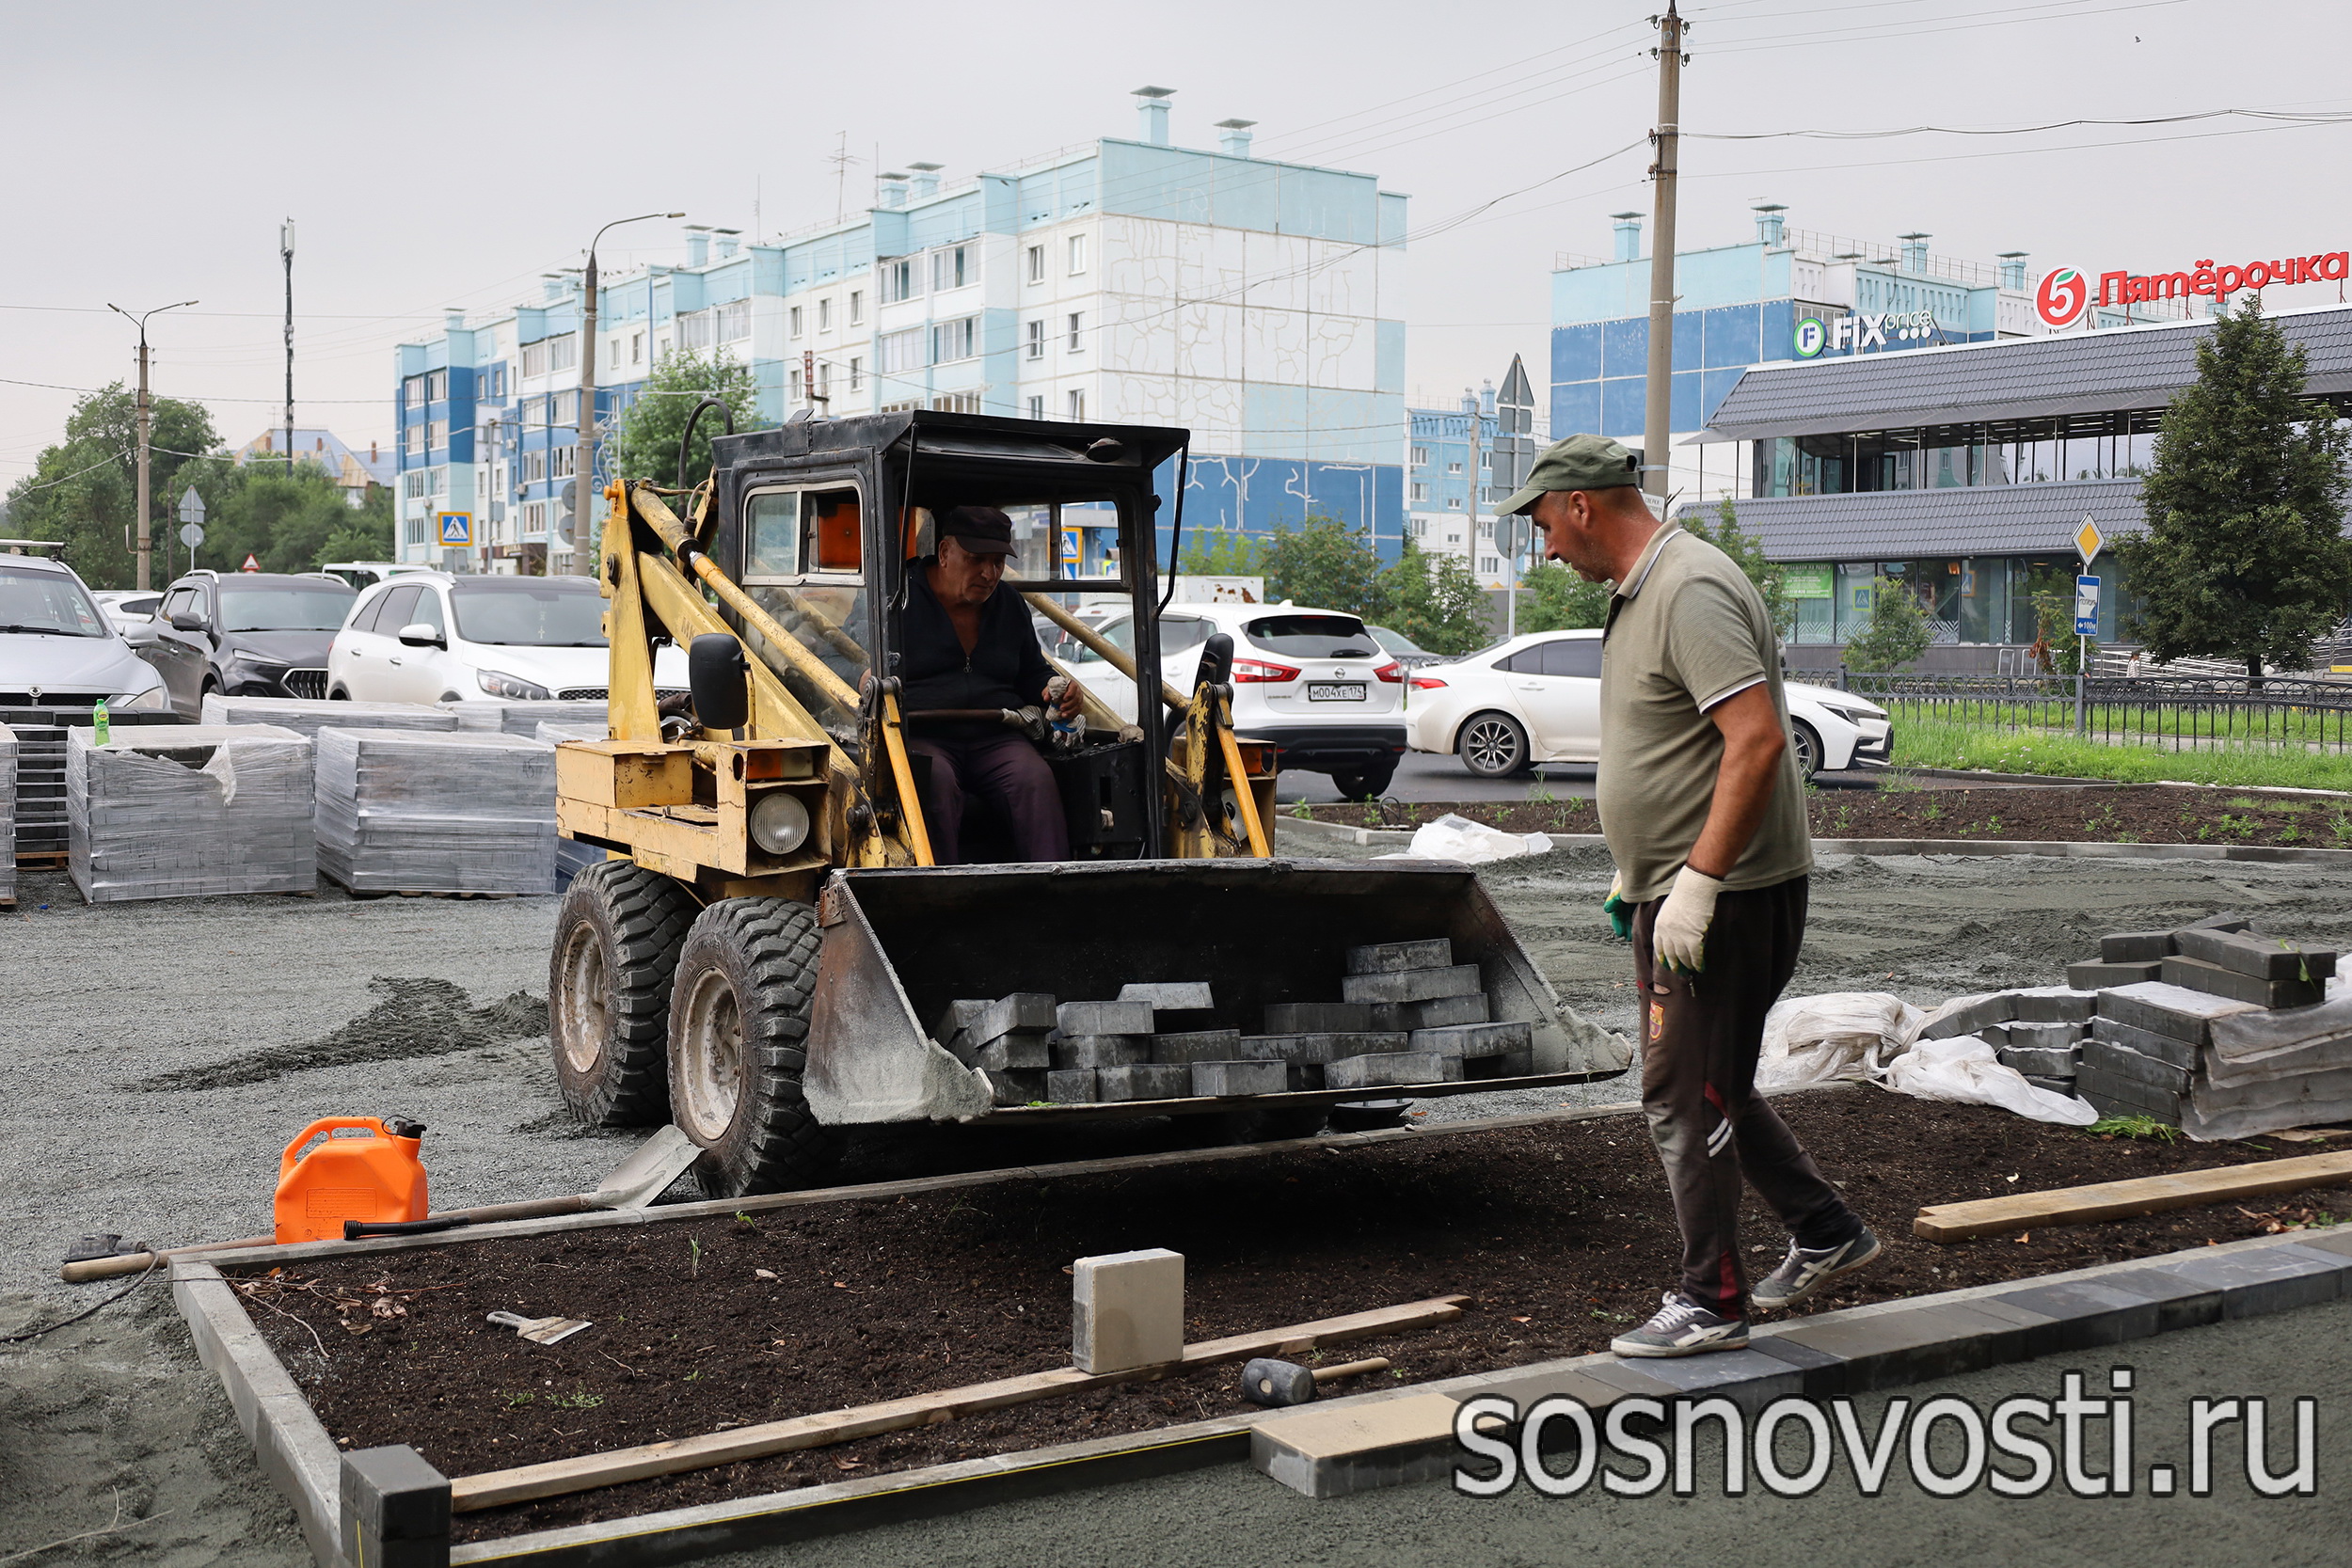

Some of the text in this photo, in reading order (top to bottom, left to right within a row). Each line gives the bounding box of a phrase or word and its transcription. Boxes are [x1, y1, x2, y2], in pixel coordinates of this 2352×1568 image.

[2047, 251, 2349, 318] 5 Пятёрочка
[1885, 309, 1931, 334] price
[1312, 687, 1362, 698] М004ХЕ 174
